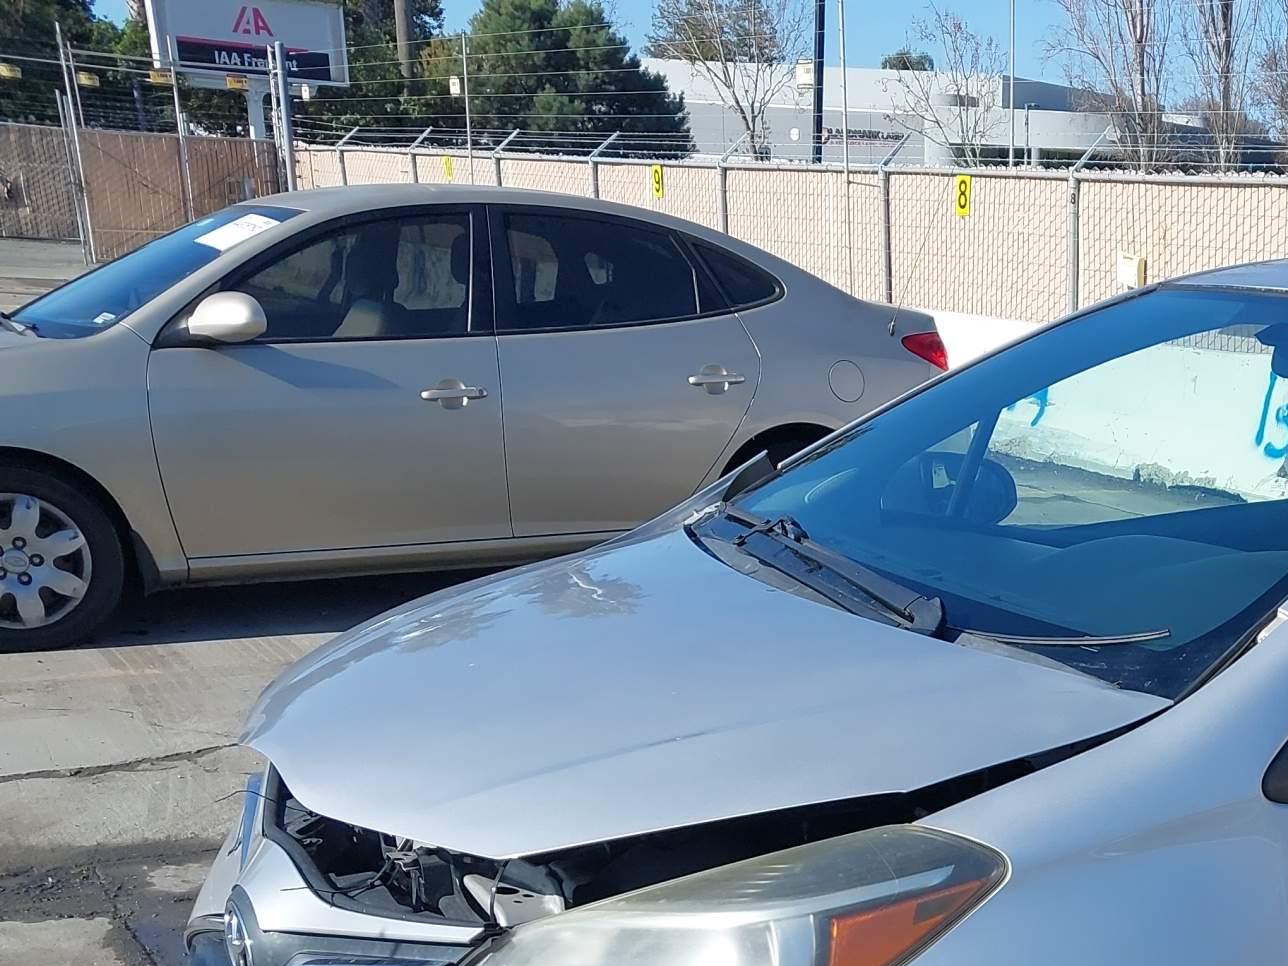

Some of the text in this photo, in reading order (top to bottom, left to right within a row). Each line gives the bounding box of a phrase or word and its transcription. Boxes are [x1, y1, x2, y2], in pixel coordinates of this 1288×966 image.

[214, 50, 298, 70] IAA Frent
[654, 169, 660, 192] 9
[958, 180, 968, 209] 8
[1070, 193, 1076, 204] 8
